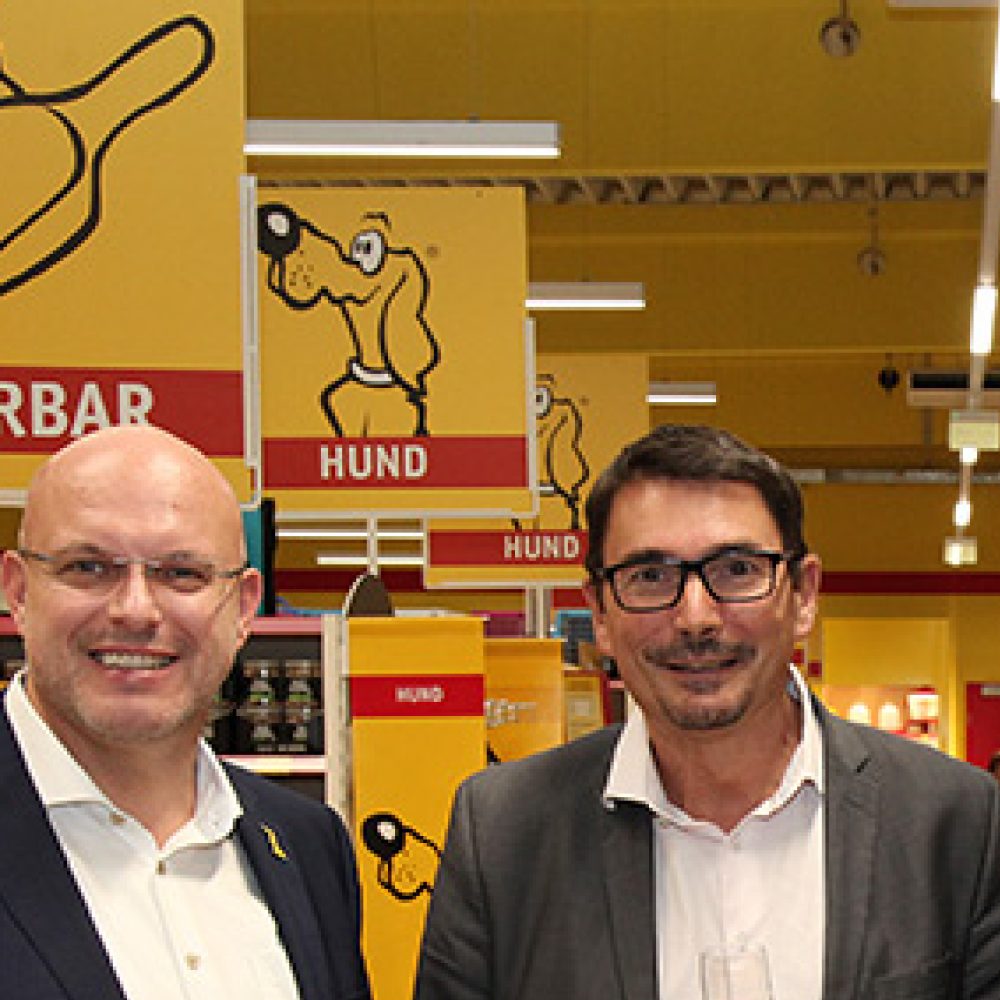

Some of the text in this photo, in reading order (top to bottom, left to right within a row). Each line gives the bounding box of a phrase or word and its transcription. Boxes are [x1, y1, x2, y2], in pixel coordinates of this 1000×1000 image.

[0, 380, 154, 438] RBAR
[320, 444, 428, 480] HUND
[503, 535, 580, 559] HUND
[394, 684, 445, 703] HUND
